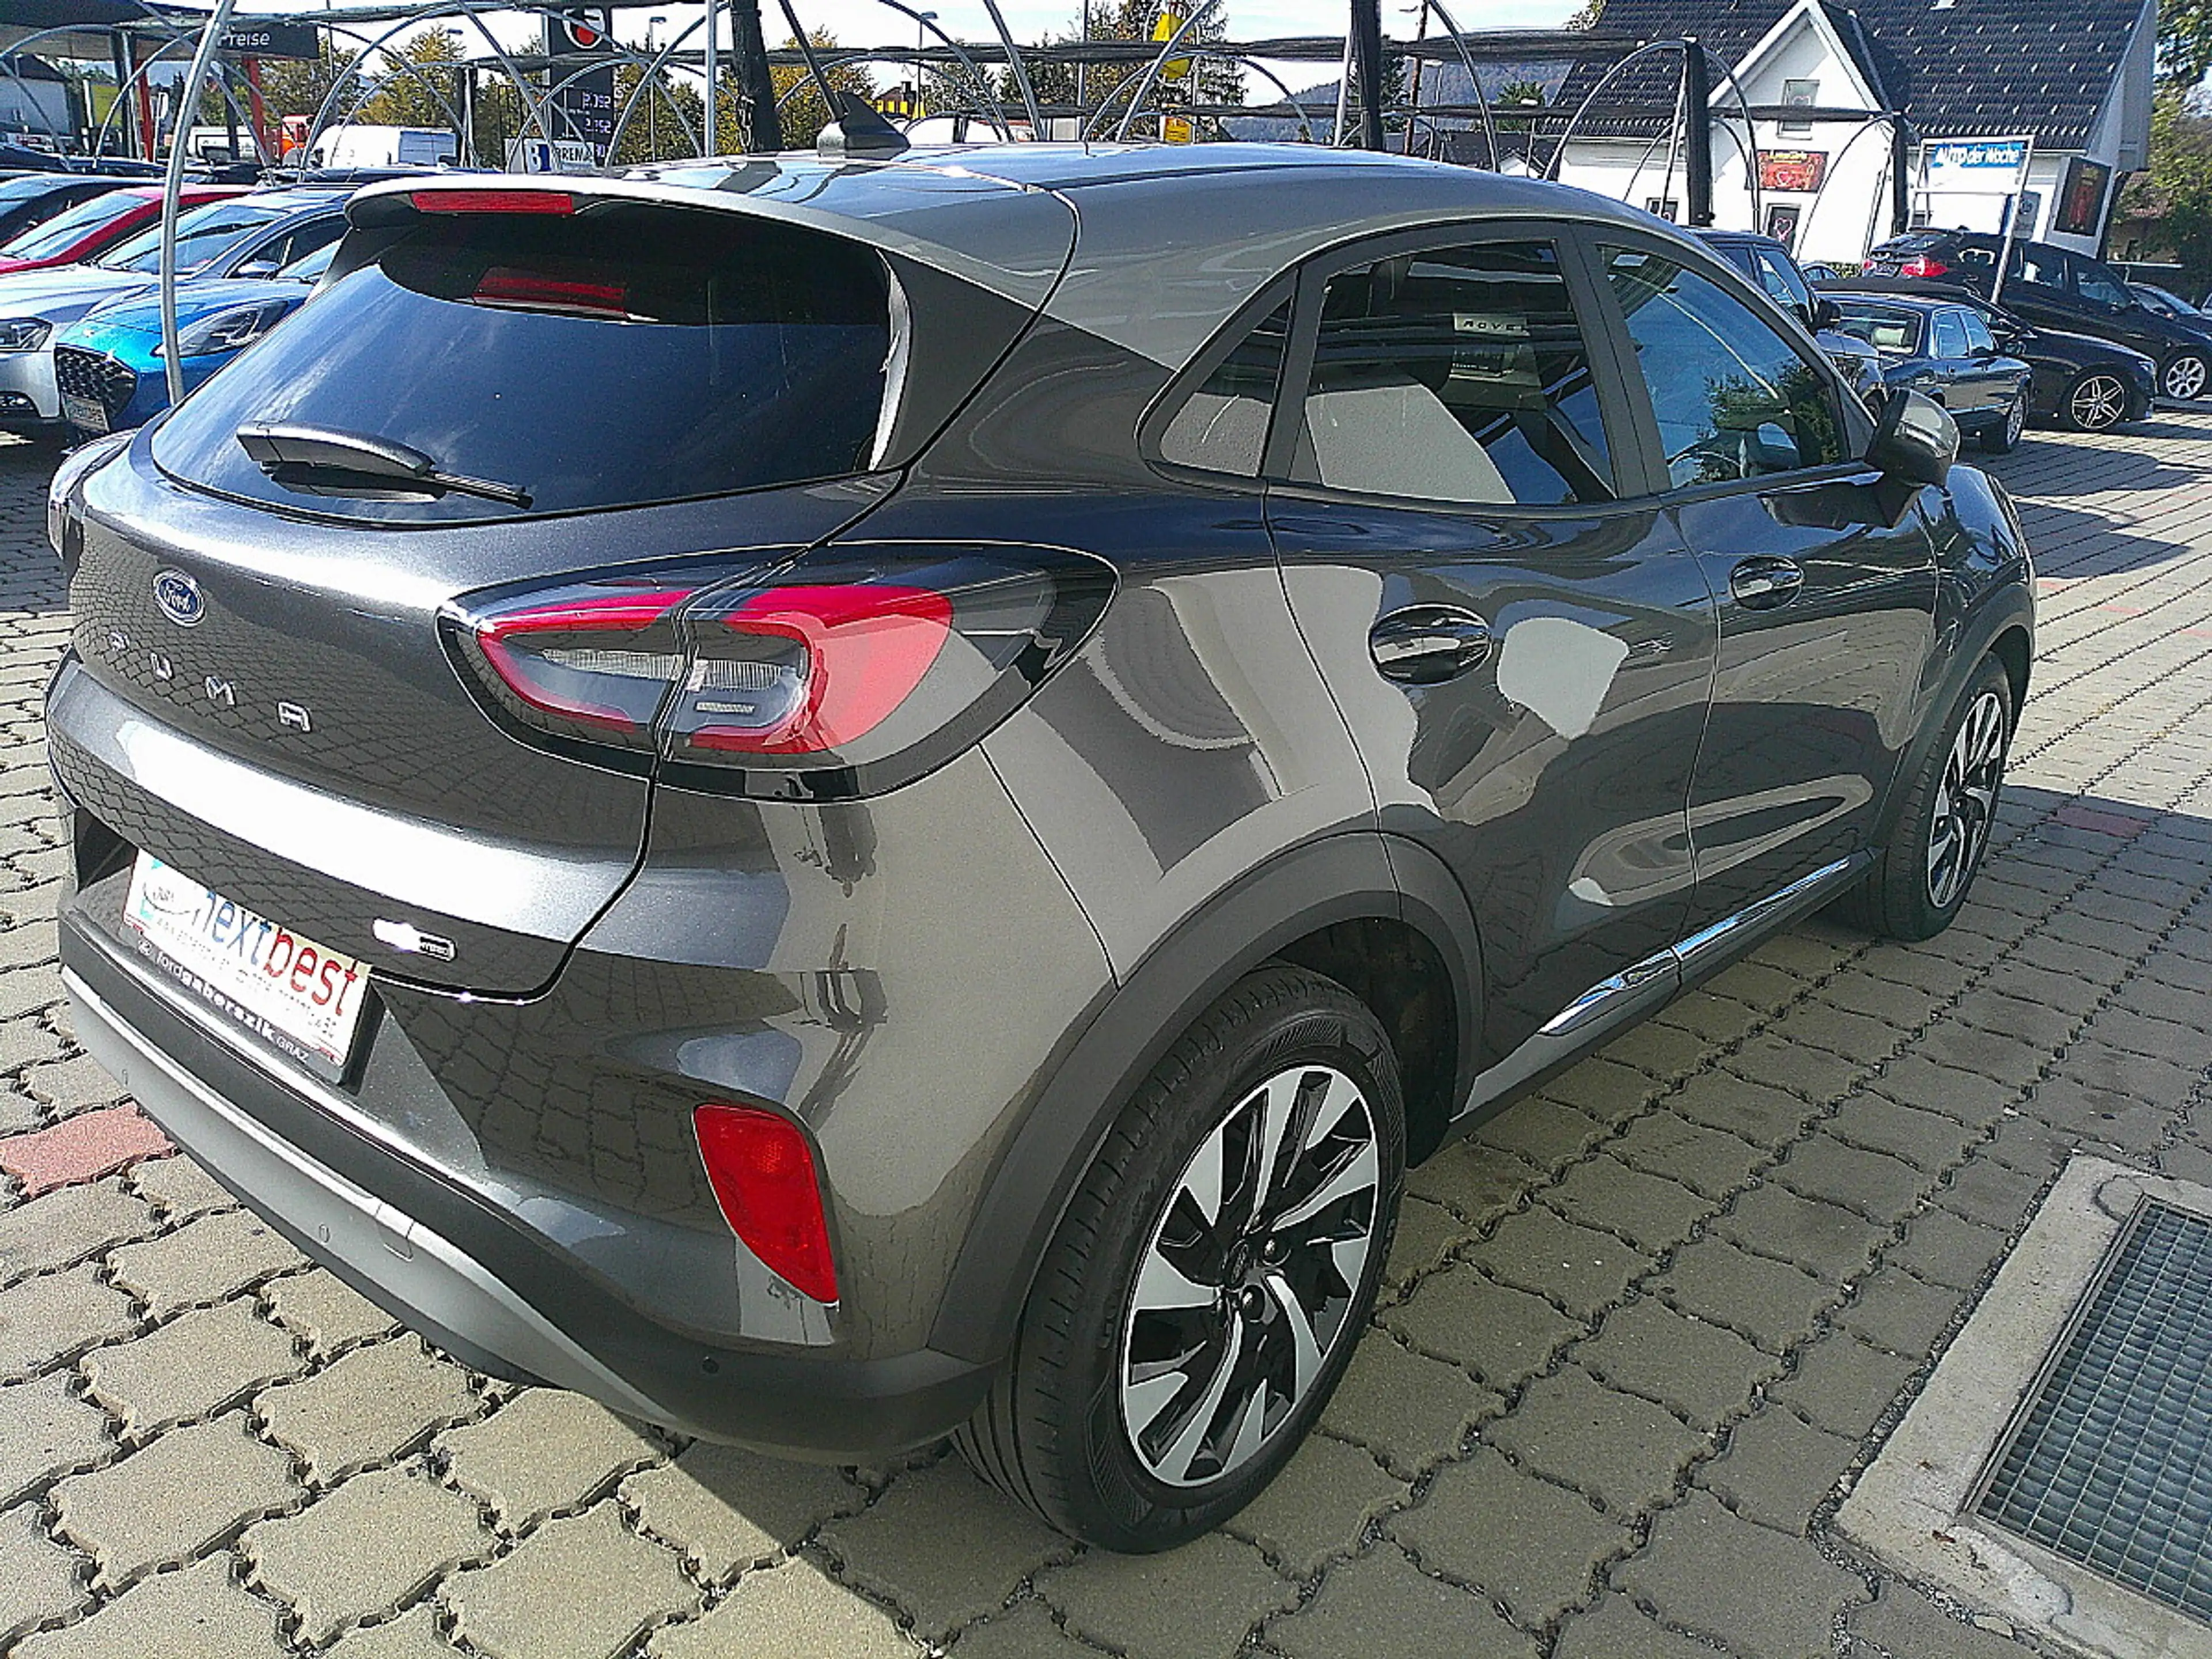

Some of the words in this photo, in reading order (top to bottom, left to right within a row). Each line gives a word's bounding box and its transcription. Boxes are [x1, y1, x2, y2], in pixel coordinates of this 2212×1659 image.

[163, 579, 192, 613] Ford
[107, 632, 312, 733] PUMA
[191, 891, 358, 1017] nextbest
[276, 1035, 309, 1064] GRAZ
